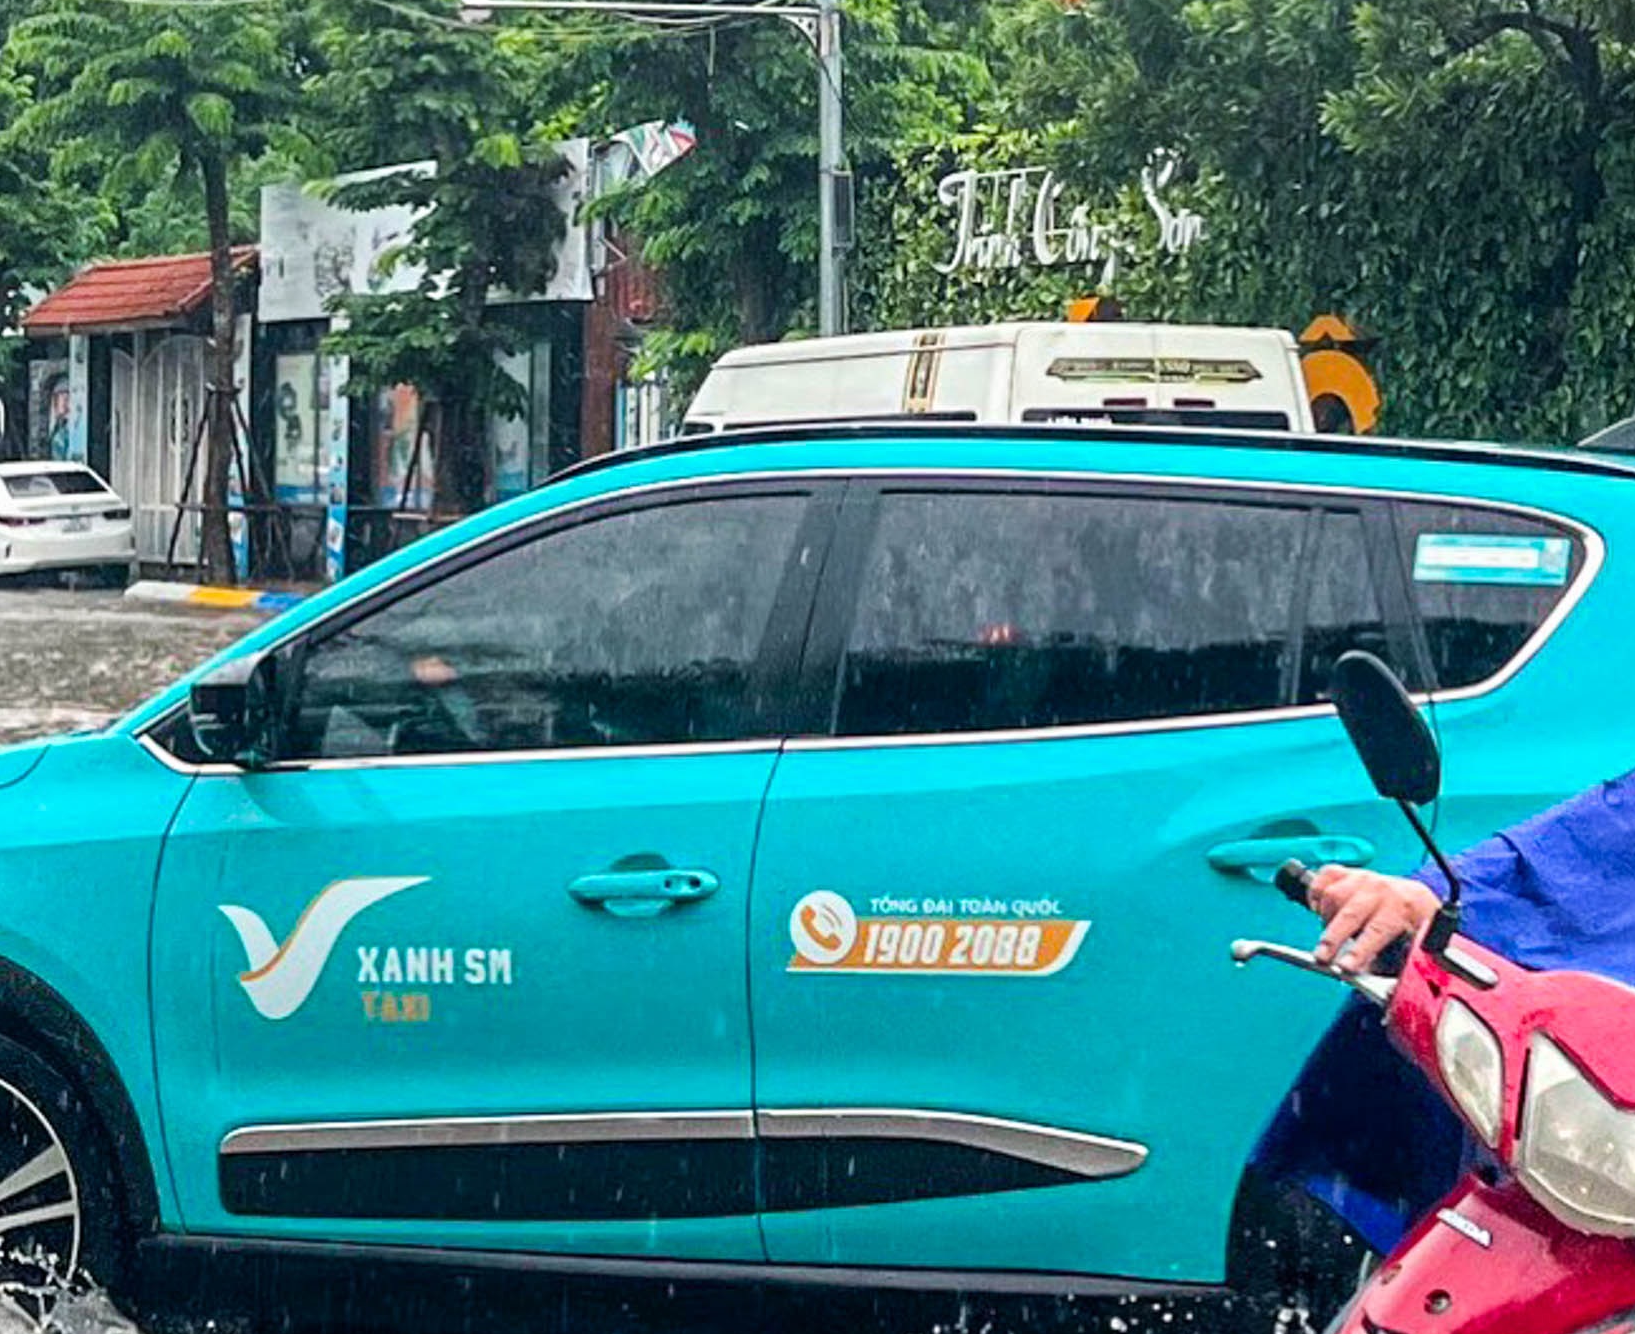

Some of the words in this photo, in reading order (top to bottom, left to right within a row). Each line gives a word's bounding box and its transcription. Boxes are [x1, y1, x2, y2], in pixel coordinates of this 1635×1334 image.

[863, 923, 945, 964] 1900
[947, 924, 1043, 966] 2088
[356, 945, 455, 984] XANH
[463, 947, 513, 985] SM
[360, 990, 430, 1023] TAXI
